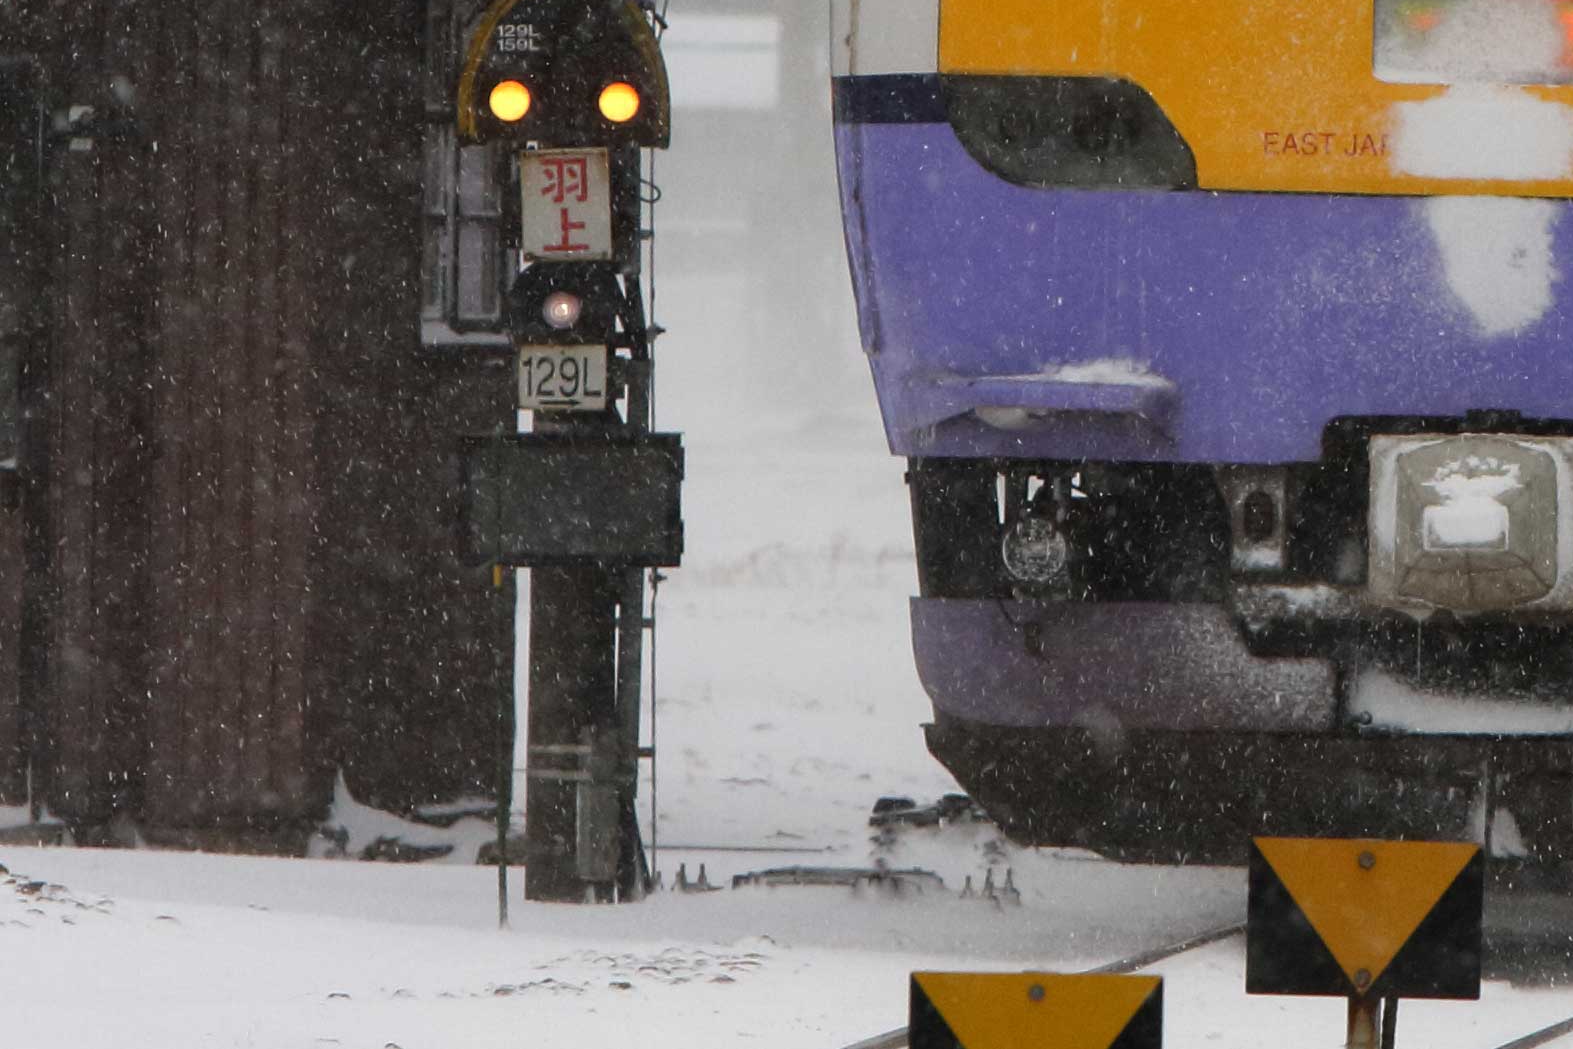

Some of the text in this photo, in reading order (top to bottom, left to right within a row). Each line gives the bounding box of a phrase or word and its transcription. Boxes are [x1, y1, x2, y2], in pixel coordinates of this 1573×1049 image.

[497, 24, 541, 38] 129L
[1263, 132, 1336, 155] EAST
[539, 156, 590, 252] 羽上
[522, 356, 602, 397] 129L
